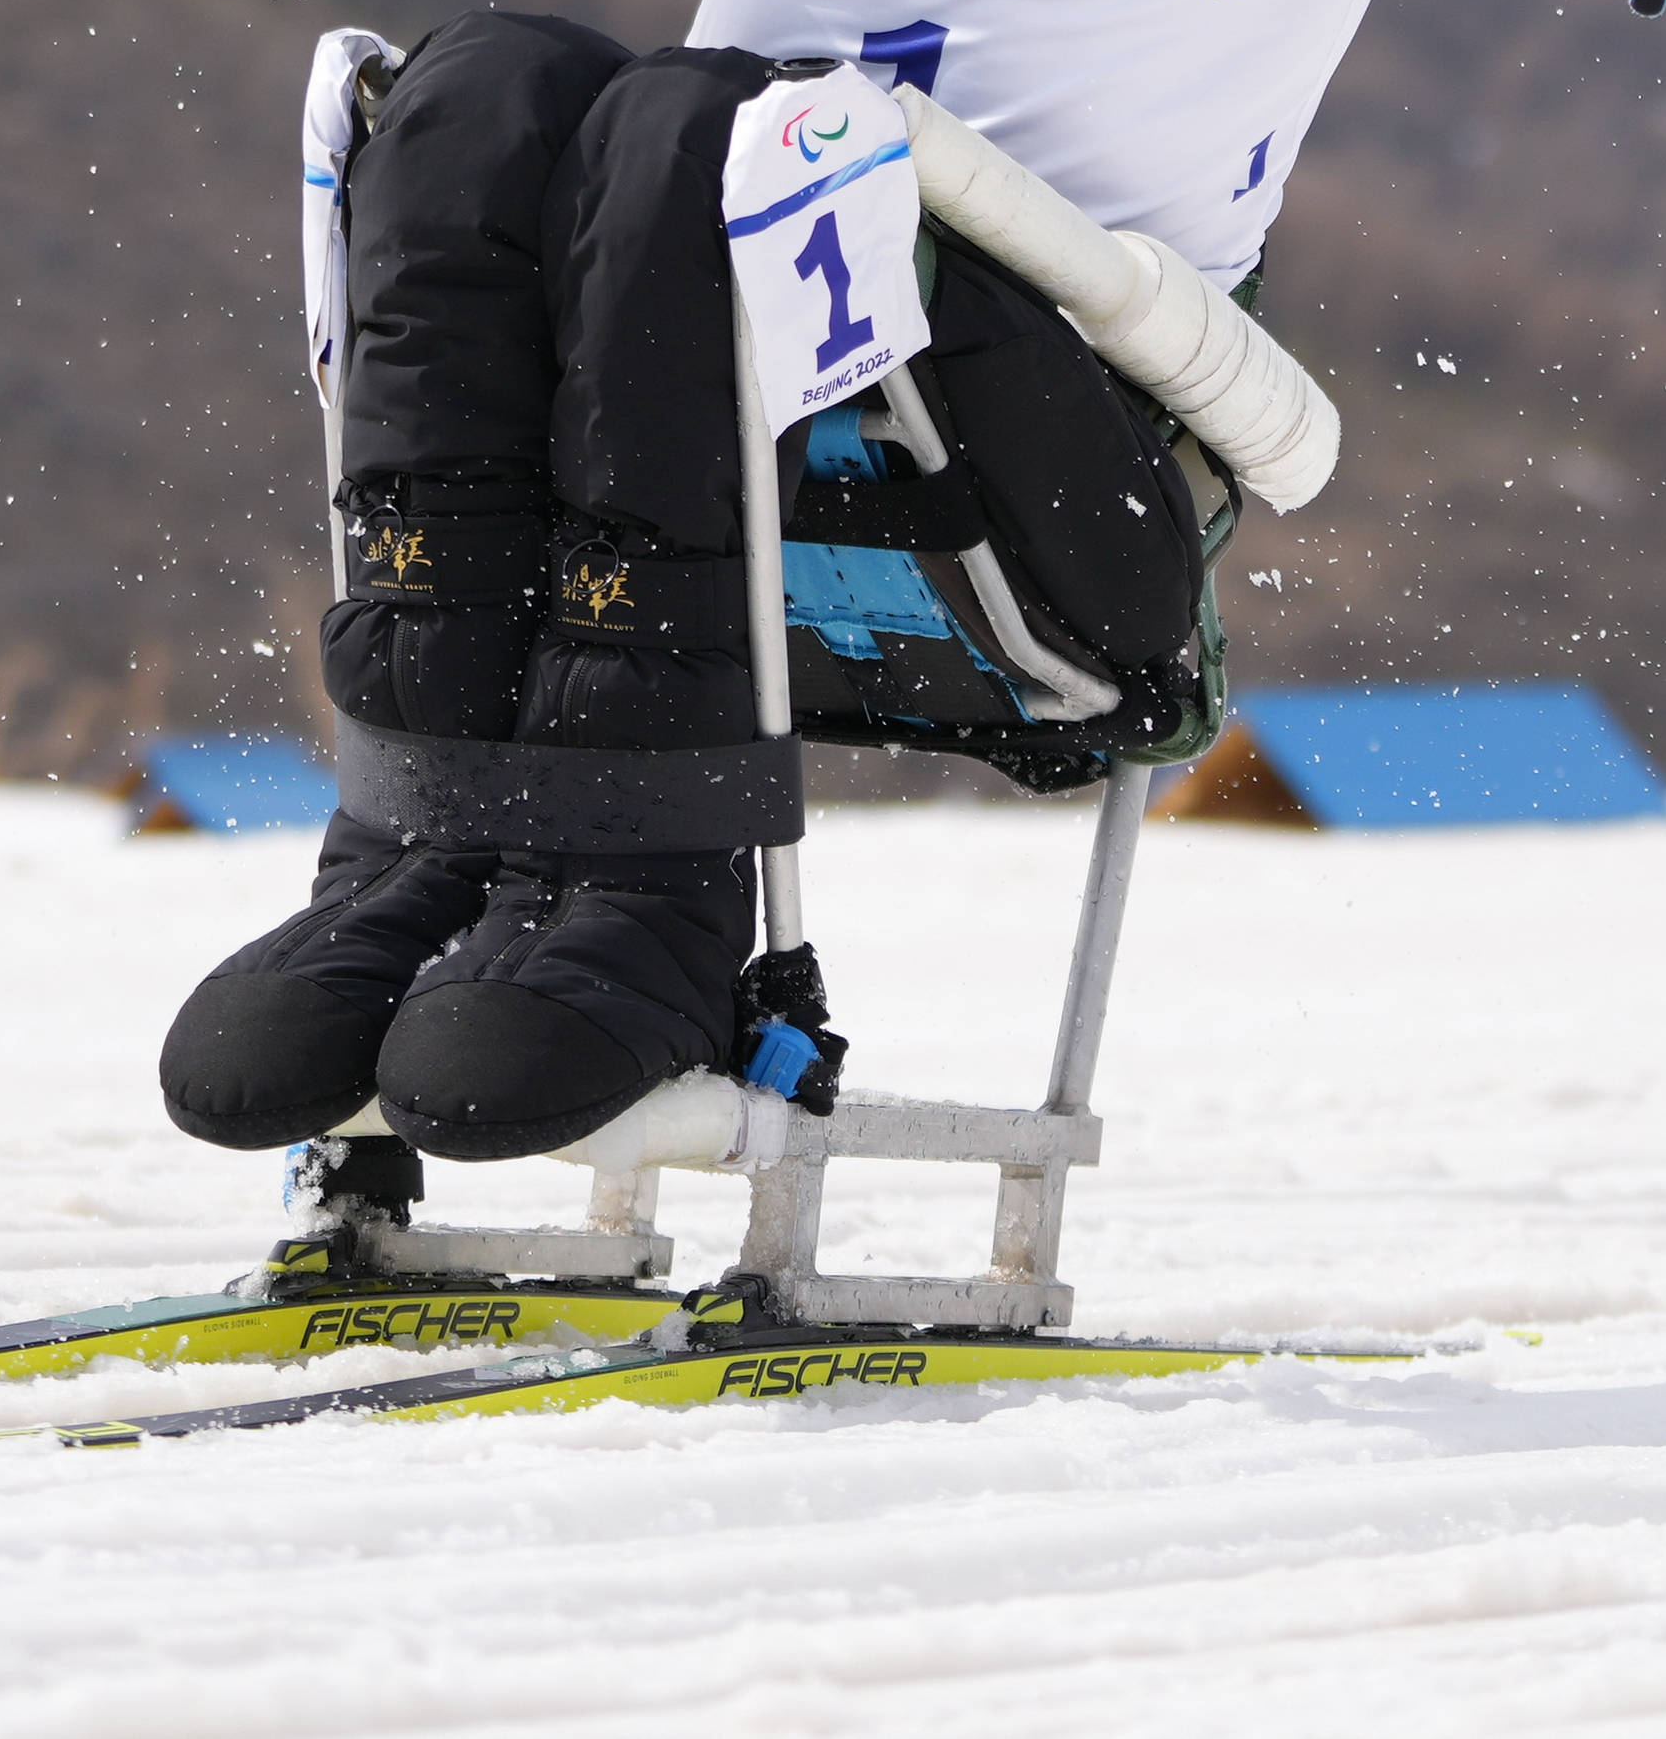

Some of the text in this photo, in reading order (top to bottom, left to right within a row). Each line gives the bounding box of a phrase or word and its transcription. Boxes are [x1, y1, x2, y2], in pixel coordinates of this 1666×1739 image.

[794, 210, 875, 374] 1
[801, 348, 895, 406] BEIJING 2022
[299, 1302, 521, 1349] FISCHER
[717, 1352, 927, 1398] FISCHER
